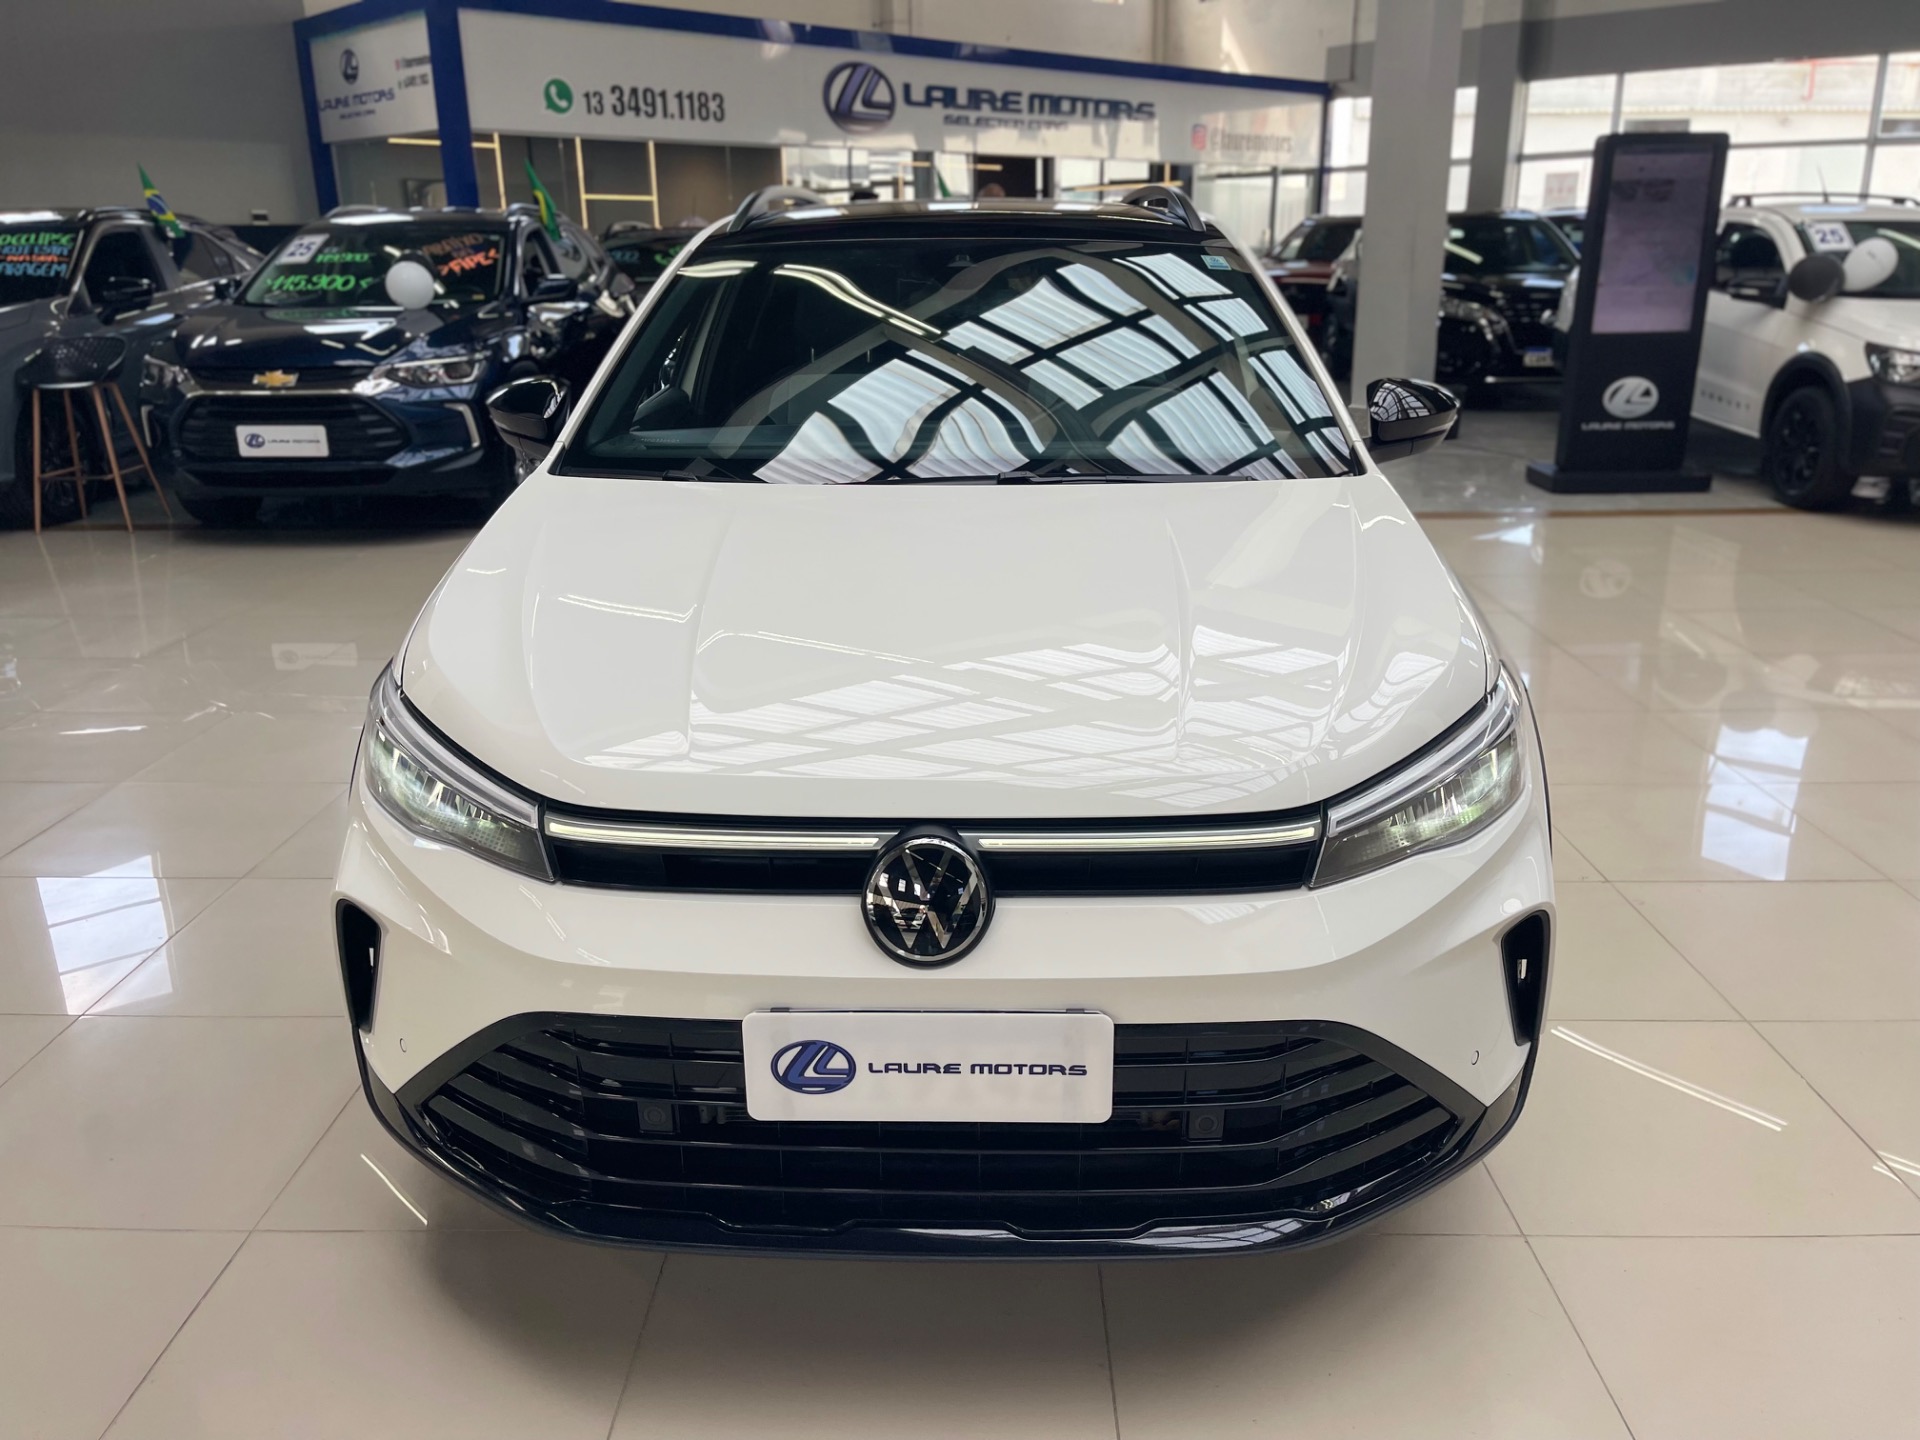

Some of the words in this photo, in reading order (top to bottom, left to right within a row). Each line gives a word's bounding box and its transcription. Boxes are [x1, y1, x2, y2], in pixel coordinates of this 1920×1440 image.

[582, 91, 604, 115] 13
[610, 85, 726, 122] 3491.1183
[903, 83, 1022, 113] LAURE
[1028, 93, 1156, 121] MOTORS
[1815, 227, 1845, 244] 25
[287, 241, 317, 257] 25
[0, 262, 67, 277] ARAGEM
[868, 1062, 962, 1074] LAURE
[970, 1063, 1088, 1075] MOTORS
